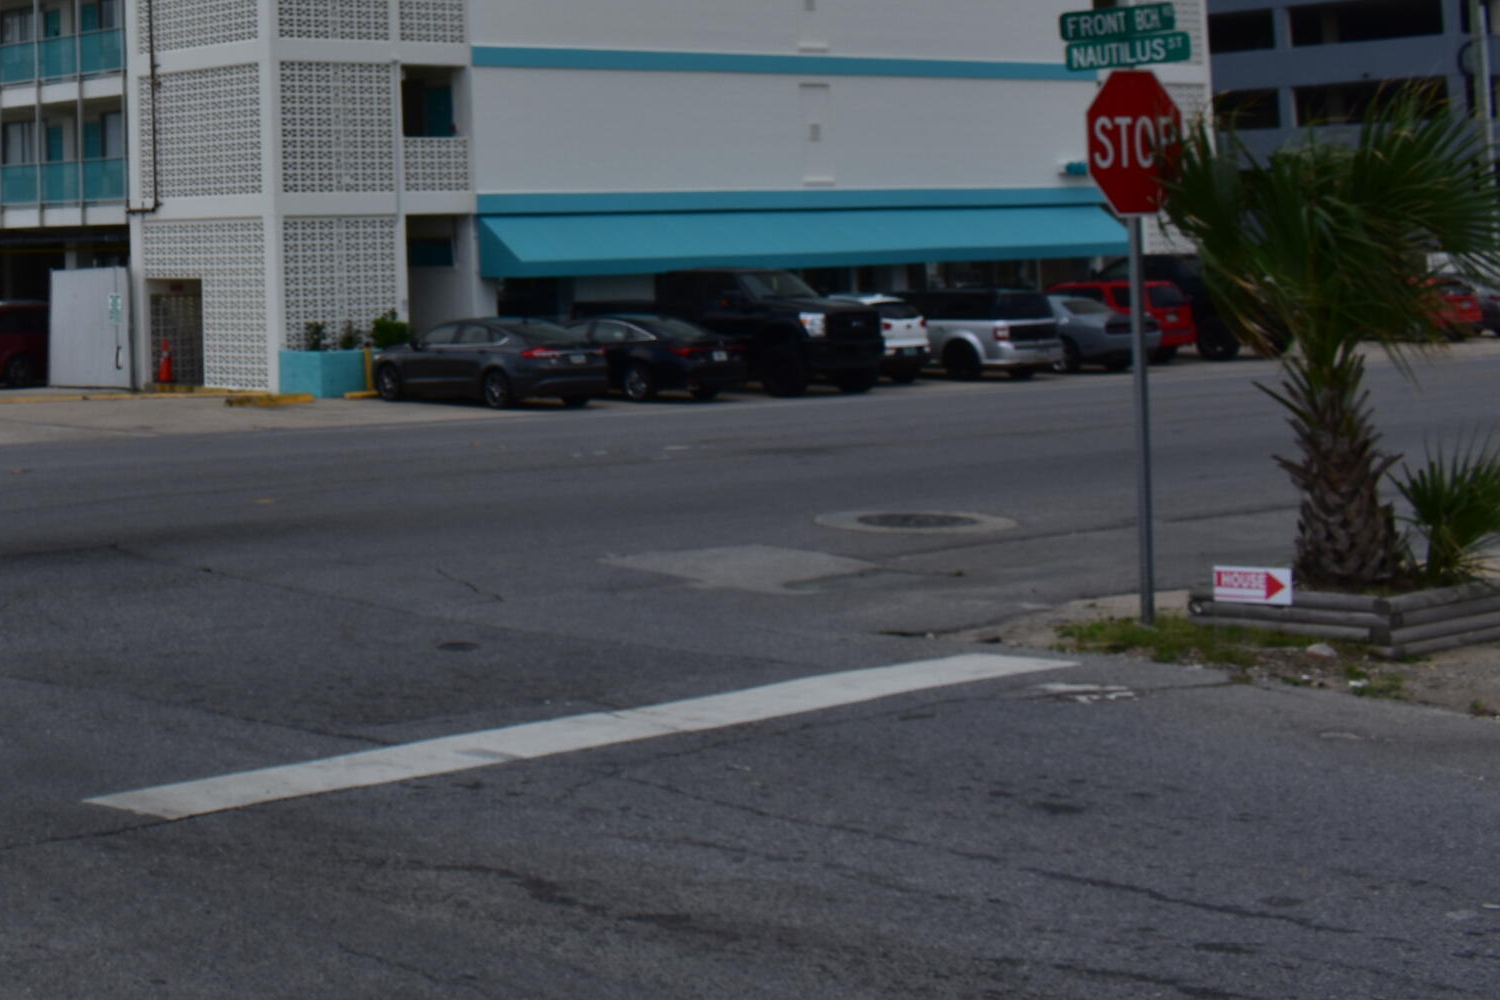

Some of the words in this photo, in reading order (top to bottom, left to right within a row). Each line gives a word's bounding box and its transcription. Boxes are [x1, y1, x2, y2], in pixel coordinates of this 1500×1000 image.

[1066, 11, 1126, 38] FRONT
[1134, 7, 1161, 30] BCH
[1071, 38, 1167, 69] NAUTILUS
